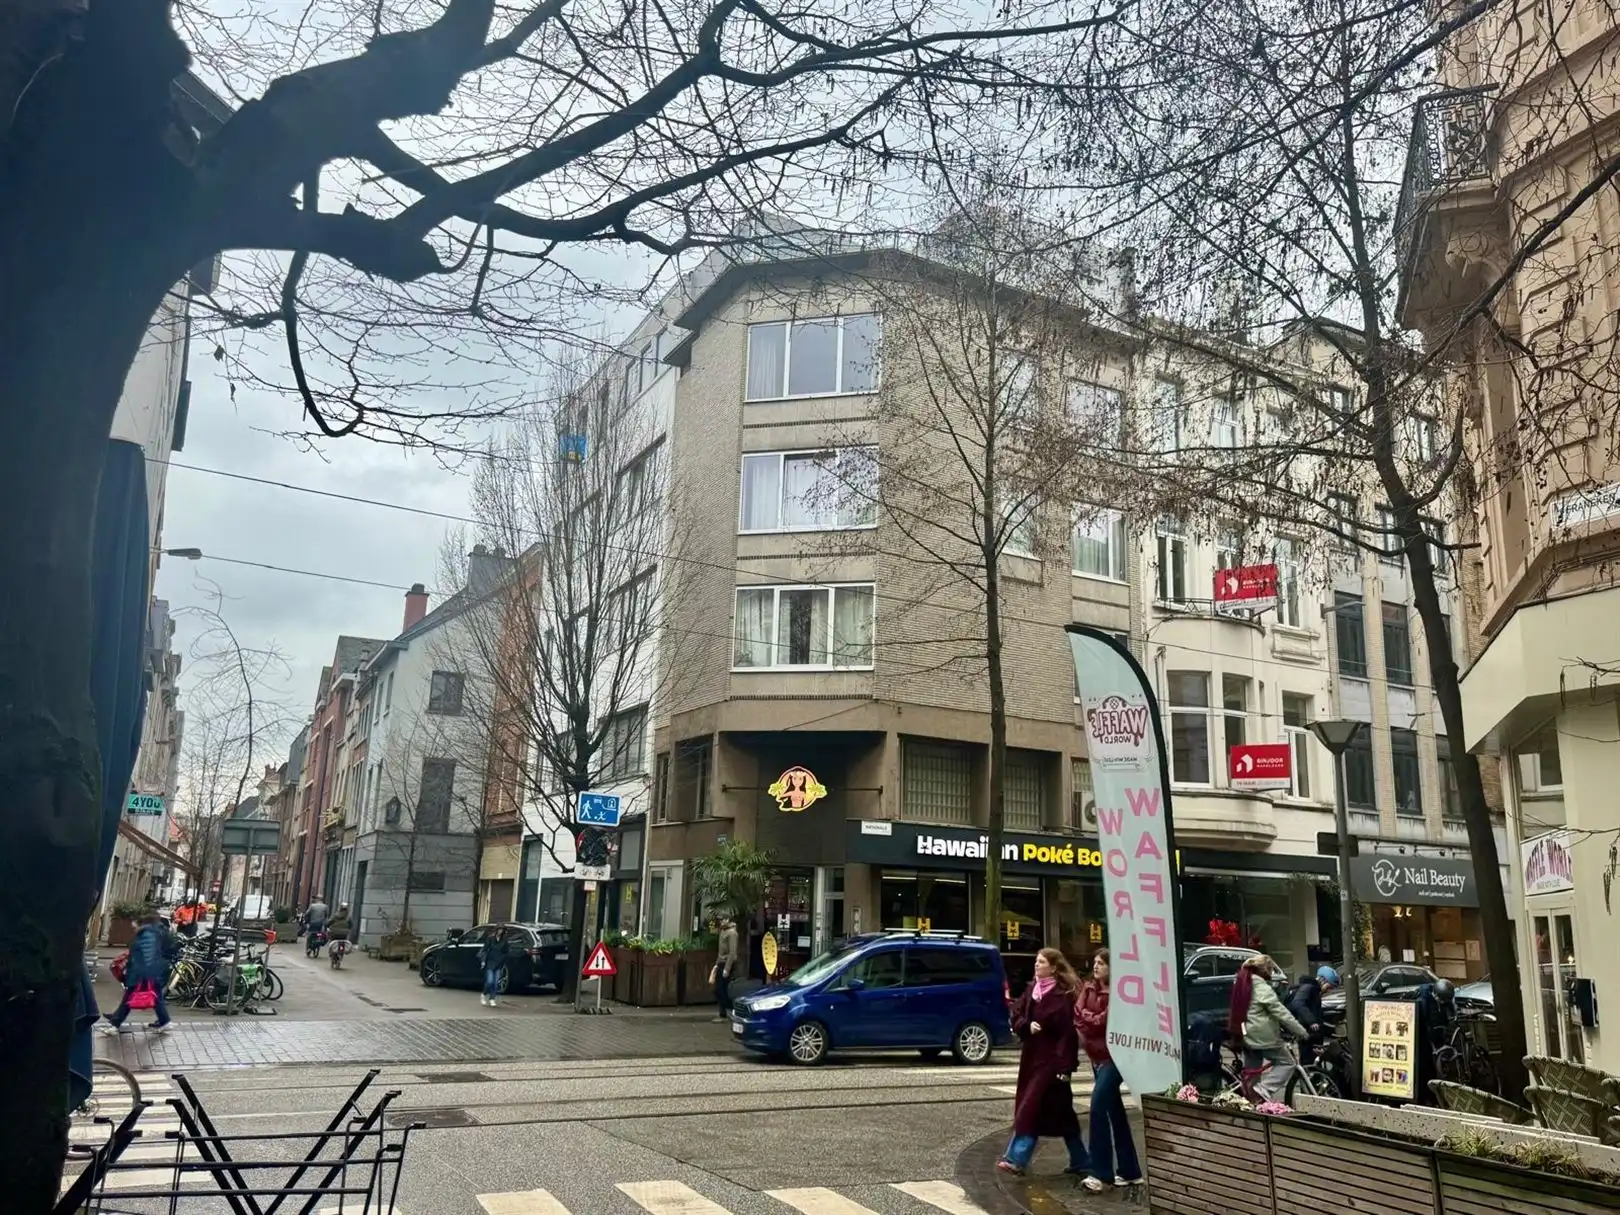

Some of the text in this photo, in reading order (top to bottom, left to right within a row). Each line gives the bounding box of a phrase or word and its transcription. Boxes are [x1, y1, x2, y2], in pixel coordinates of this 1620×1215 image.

[917, 835, 1019, 861] Hawaiin
[1404, 867, 1428, 885] Nail
[1430, 870, 1466, 893] Beauty
